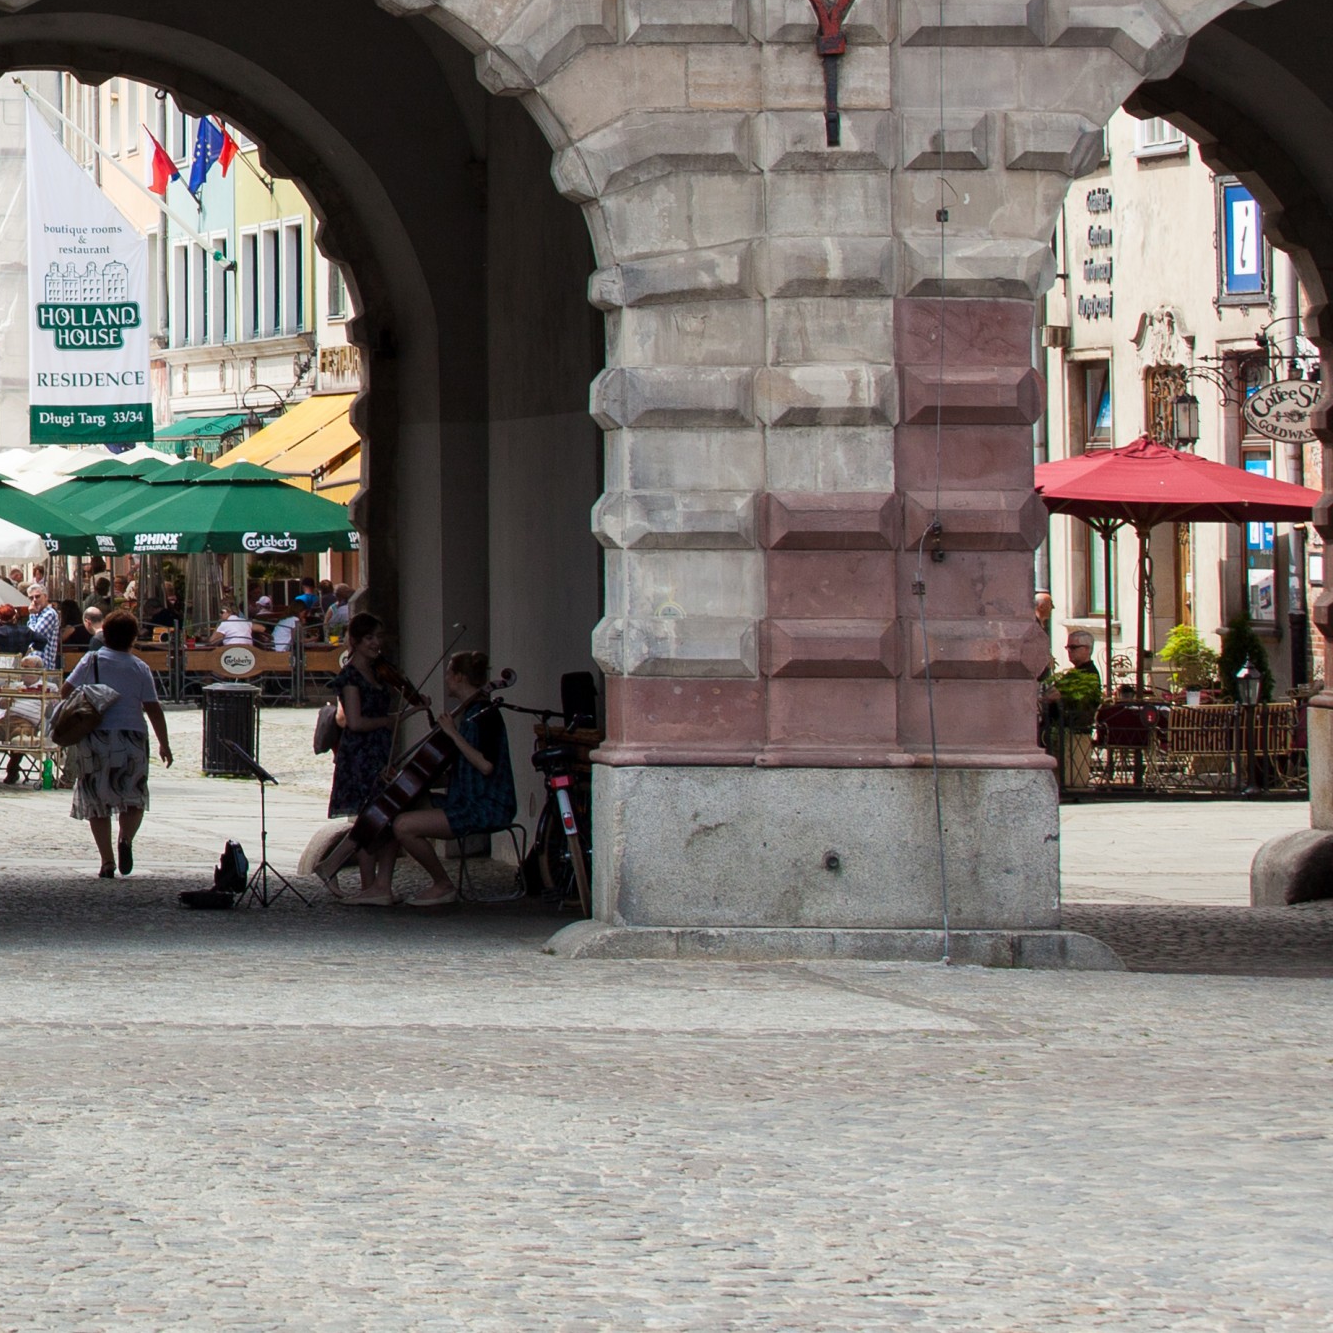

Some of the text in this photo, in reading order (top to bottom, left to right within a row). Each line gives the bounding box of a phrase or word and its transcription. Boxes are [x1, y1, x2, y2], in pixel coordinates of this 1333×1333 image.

[44, 224, 122, 236] boutique rooms
[78, 235, 87, 244] &
[59, 245, 110, 254] restaurant
[40, 307, 137, 326] HOLLAND
[58, 328, 121, 346] HOUSE
[37, 371, 145, 387] RESIDENCE
[1251, 386, 1297, 417] Coffee
[39, 410, 144, 427] Długi Targ 33/34
[134, 532, 179, 545] SPHINX
[242, 532, 297, 553] Carlsberg
[223, 655, 252, 668] Carlsberg
